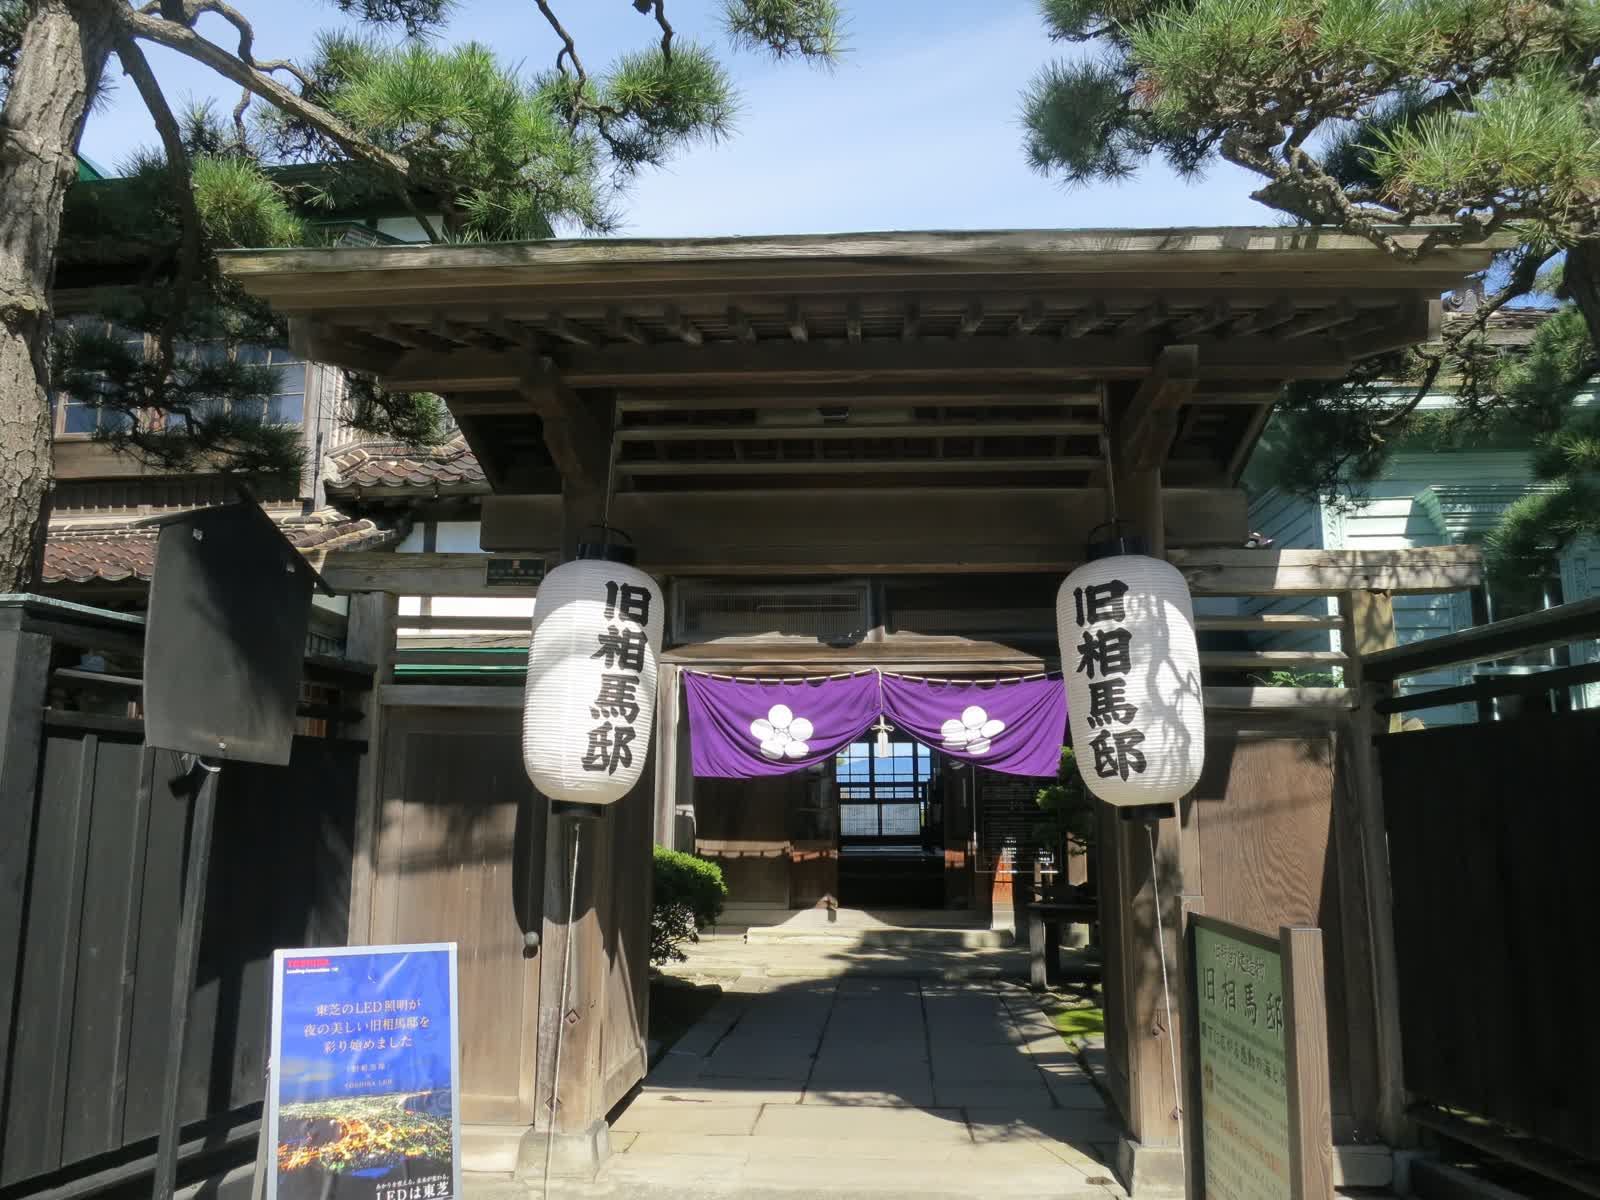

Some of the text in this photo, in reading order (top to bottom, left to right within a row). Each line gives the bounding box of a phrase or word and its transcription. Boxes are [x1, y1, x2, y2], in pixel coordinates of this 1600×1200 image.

[581, 580, 652, 777] 旧相馬邸
[1073, 579, 1148, 782] 旧相馬邸
[315, 999, 421, 1017] 東芝のLED照明が
[304, 1016, 431, 1037] 夜の美しい旧相馬邸を
[324, 1035, 412, 1054] 彩り始めました
[376, 1182, 449, 1200] LEDは東芝
